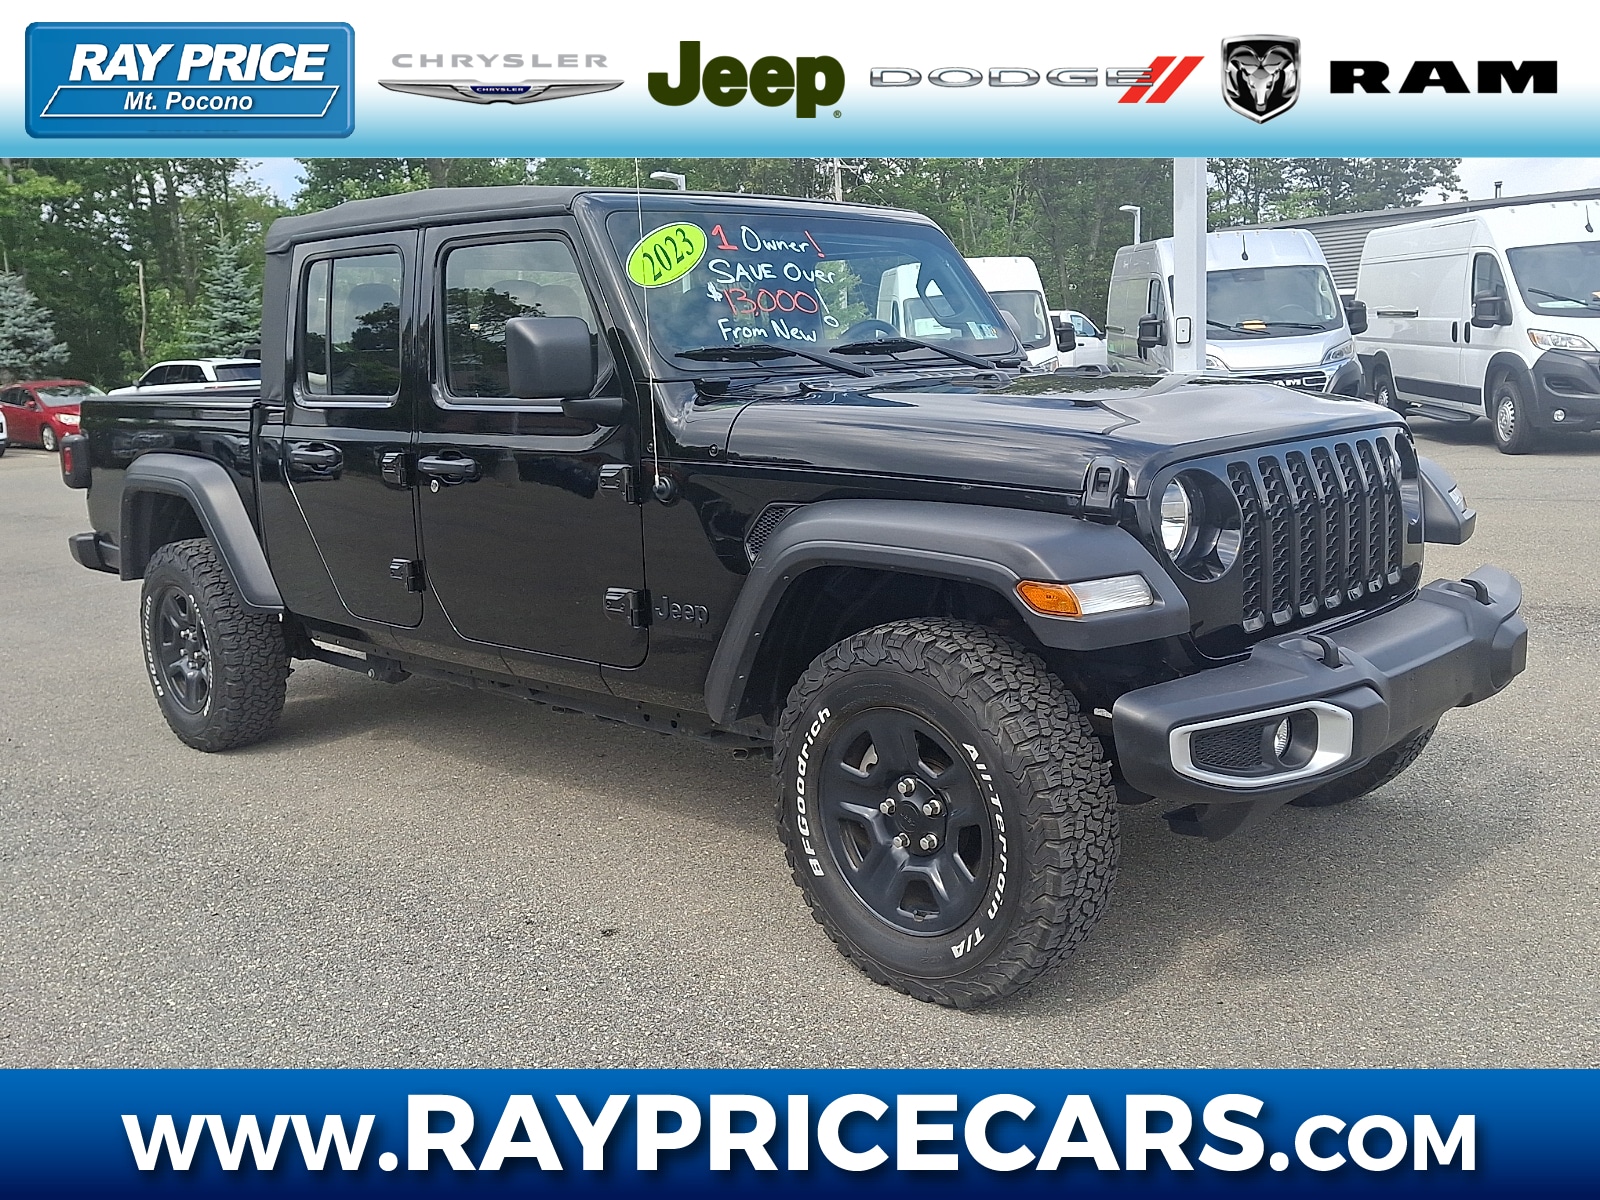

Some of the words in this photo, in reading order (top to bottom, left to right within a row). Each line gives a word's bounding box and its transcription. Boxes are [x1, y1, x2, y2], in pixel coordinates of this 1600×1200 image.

[642, 227, 695, 282] 2023
[711, 224, 739, 251] 1
[717, 317, 769, 342] From
[655, 595, 710, 628] Jeep
[796, 706, 831, 877] BFGoodrich
[962, 742, 1008, 921] All-Terrain
[950, 926, 986, 960] T/A
